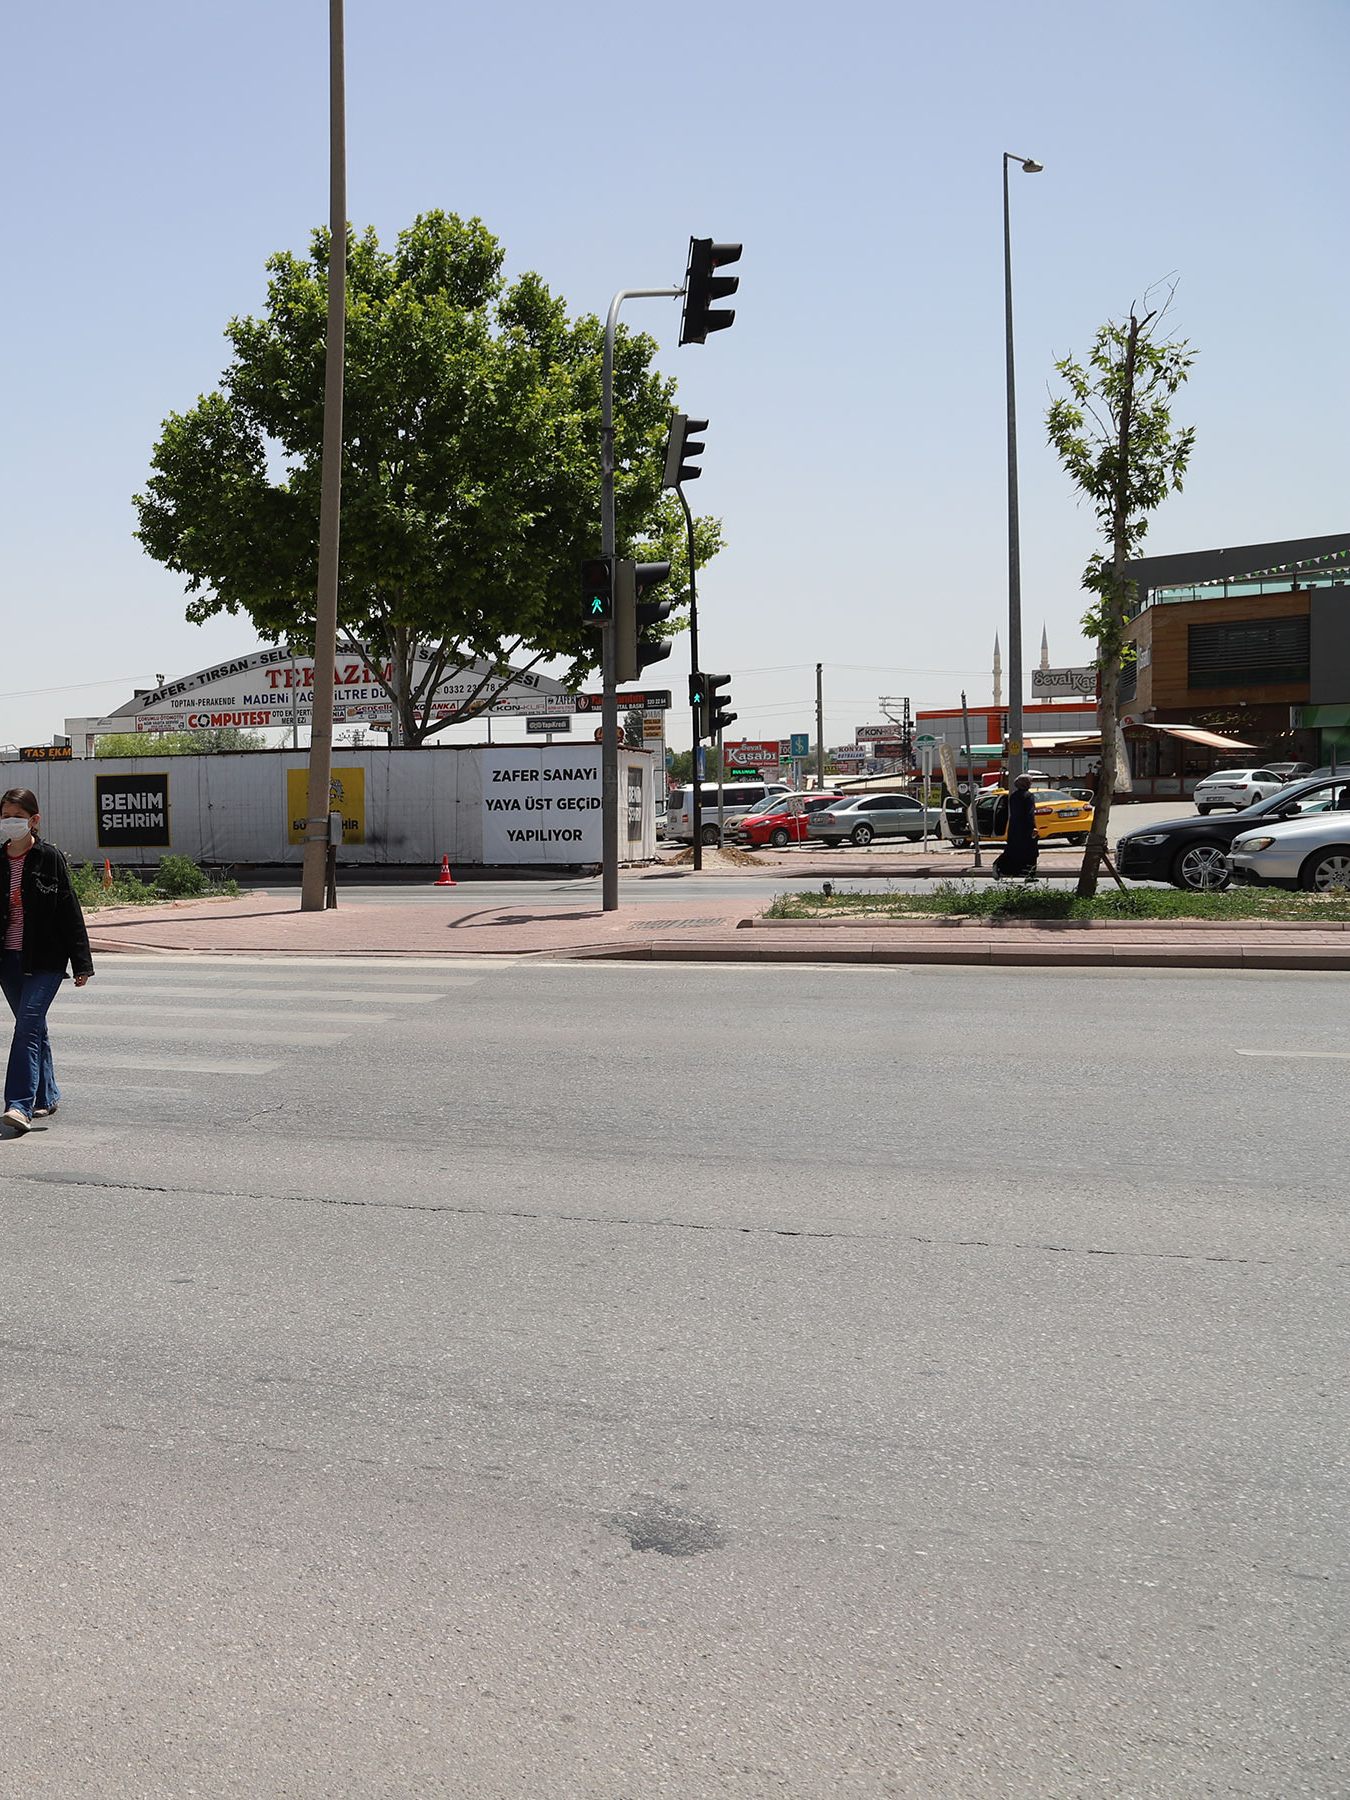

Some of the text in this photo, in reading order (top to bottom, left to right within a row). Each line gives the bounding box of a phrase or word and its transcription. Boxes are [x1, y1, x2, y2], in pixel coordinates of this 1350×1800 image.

[143, 683, 186, 706] ZAFER
[197, 659, 249, 684] TIRSAN
[443, 685, 465, 694] 0332
[1034, 670, 1097, 693] Seval Kas
[171, 697, 236, 708] TOPTAN-PERAKENDE
[243, 692, 289, 704] MADENİ
[334, 688, 368, 700] İLTRE
[188, 711, 271, 728] COMPUTEST
[272, 710, 284, 718] OTO
[281, 717, 307, 725] MEREZİ
[726, 748, 777, 764] Kasabı
[492, 768, 597, 782] ZAFER SANAYİ
[101, 792, 163, 810] BENİM
[485, 796, 603, 812] YAYA ÜST GEÇİDİ
[102, 813, 164, 831] ŞEHRİM
[506, 829, 583, 842] YAPILIYOR
